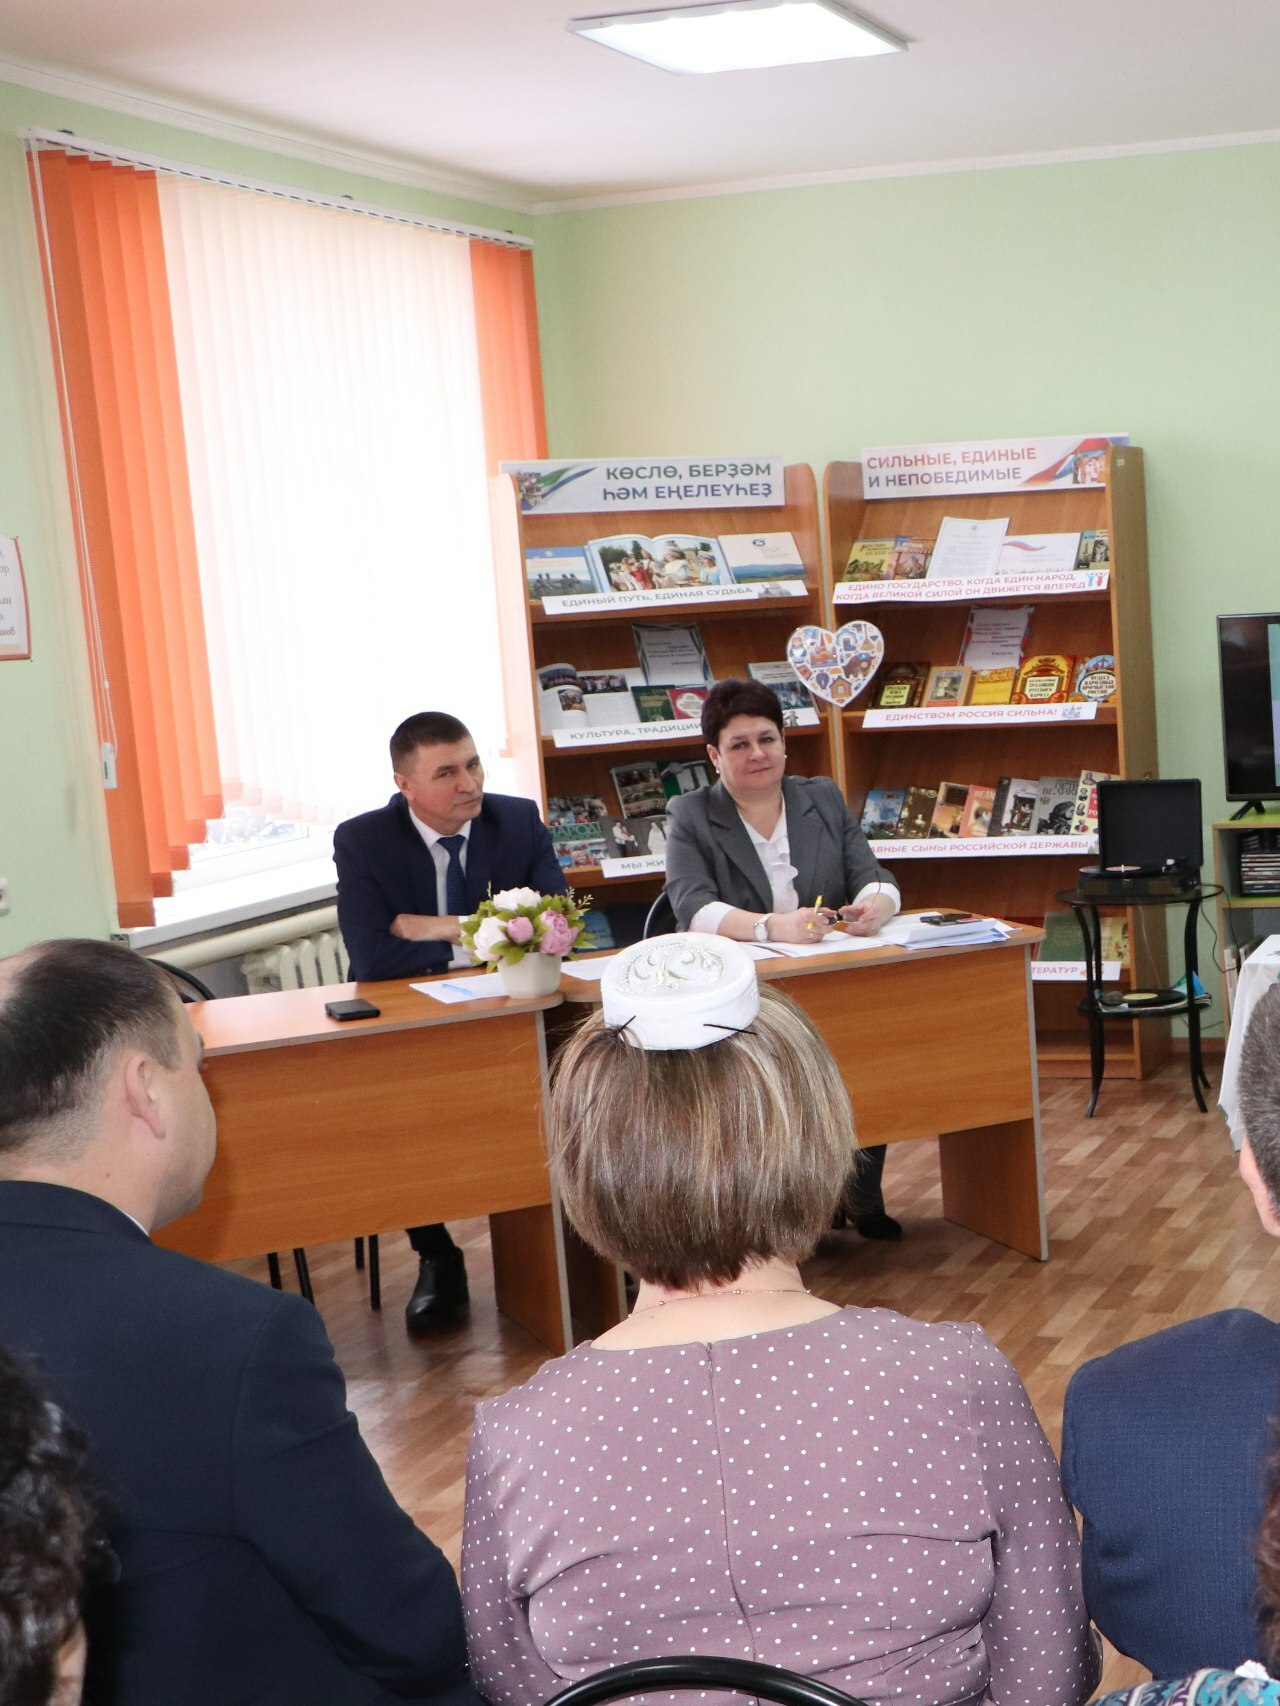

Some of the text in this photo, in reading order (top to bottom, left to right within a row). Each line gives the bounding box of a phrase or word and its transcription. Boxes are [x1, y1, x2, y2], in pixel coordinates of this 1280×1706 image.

[866, 447, 1037, 470] СИЛЬНЫЕ, ЕДИНЫЕ
[868, 467, 1022, 488] И НЕПОБЕДИМЫЕ
[836, 581, 1086, 601] КОГДА ВЕЛИКОЙ СИЛОЙ ОН ДВИЖЕТСЯ ВПЕРЕД
[848, 573, 1076, 592] ЕДИНО ГОСУДАРСТВО, КОГДА ЕДИН НАРОД,
[562, 597, 615, 608] ЕДИНЫЙ
[655, 589, 703, 601] ЕДИНАЯ
[706, 586, 753, 598] СУДЬБА
[885, 707, 1058, 722] ЕДИНСТВОМ РОССИЯ СИЛЬНА!
[570, 722, 701, 741] КУЛЬТУРА, ТРАДИЦИИ
[870, 840, 1088, 853] АВНЫЕ СЫНЫ РОССИЙСКОЙ ДЕРЖАВЫ
[621, 861, 643, 871] МЫ
[1032, 966, 1078, 974] ТЕРАТУР
